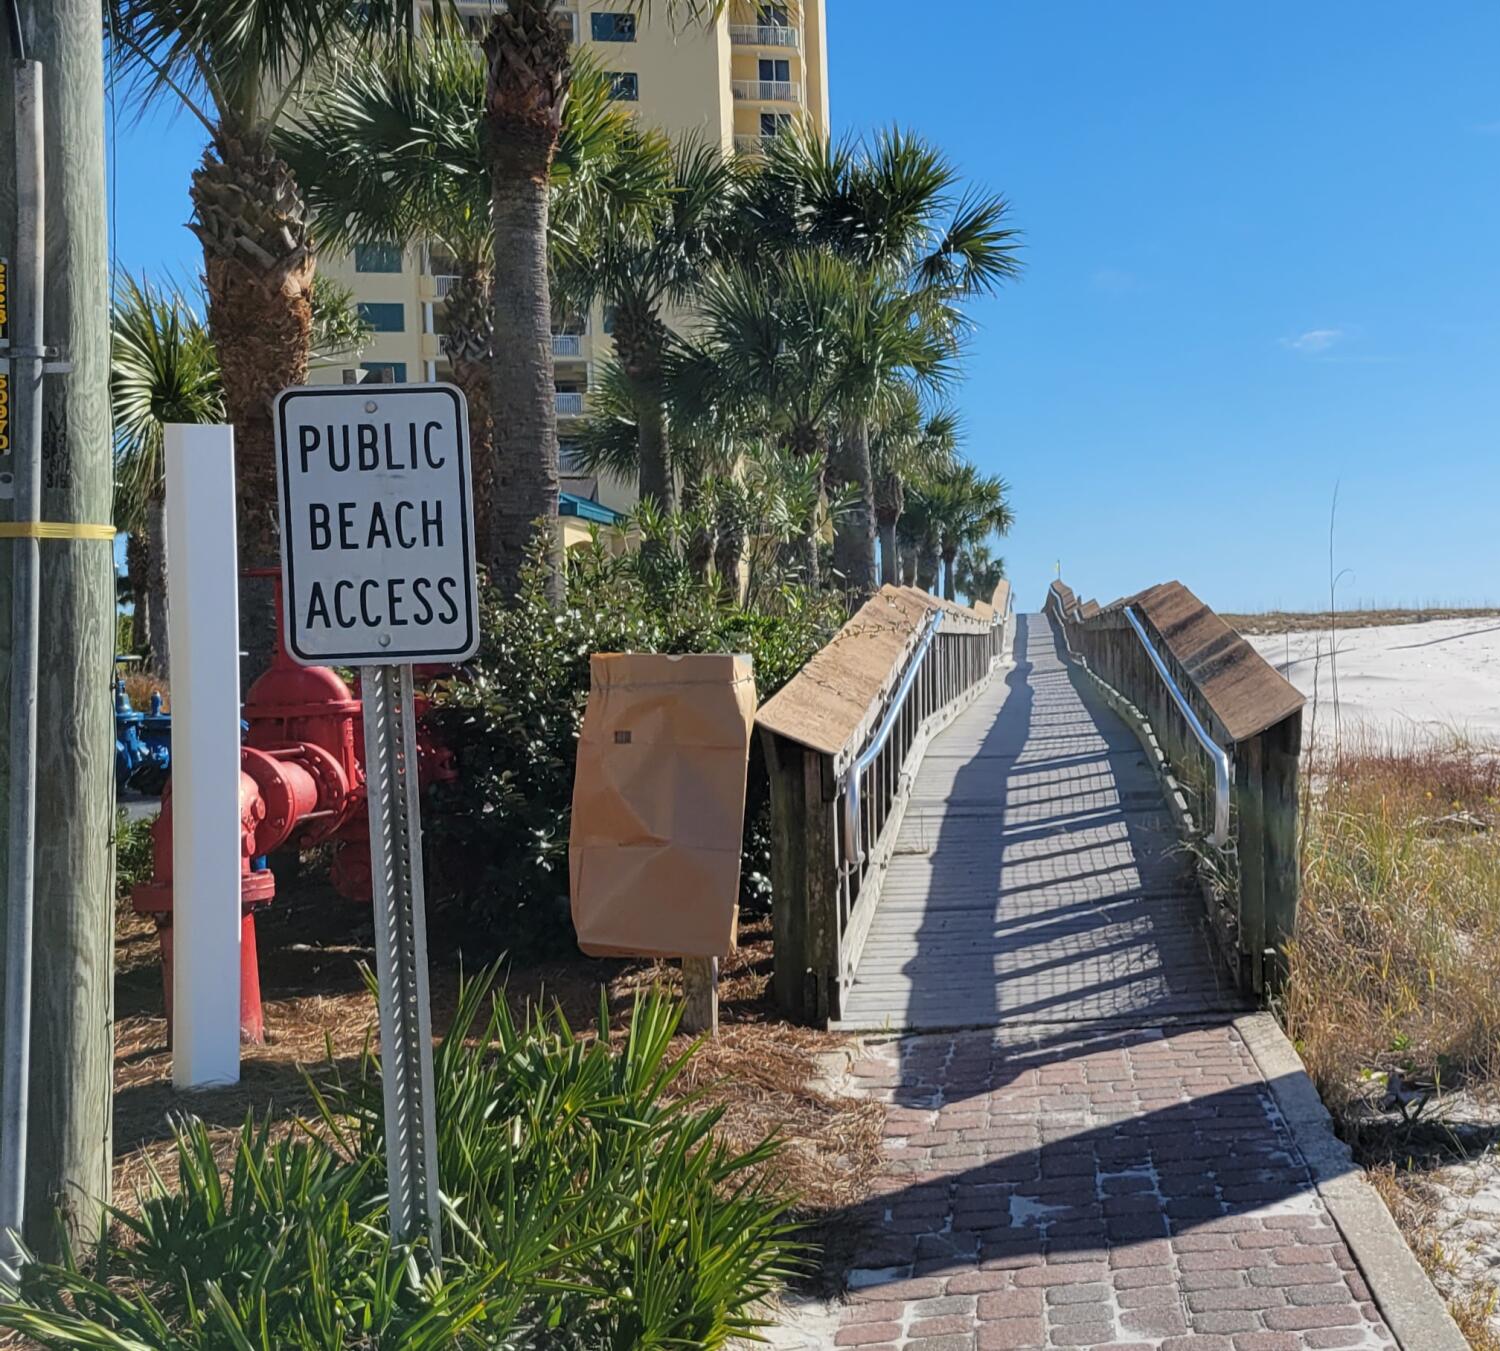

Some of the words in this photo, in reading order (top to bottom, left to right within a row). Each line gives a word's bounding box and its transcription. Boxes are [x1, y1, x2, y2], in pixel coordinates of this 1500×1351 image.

[298, 421, 447, 473] PUBLIC
[309, 501, 445, 552] BEACH
[305, 577, 459, 629] ACCESS
